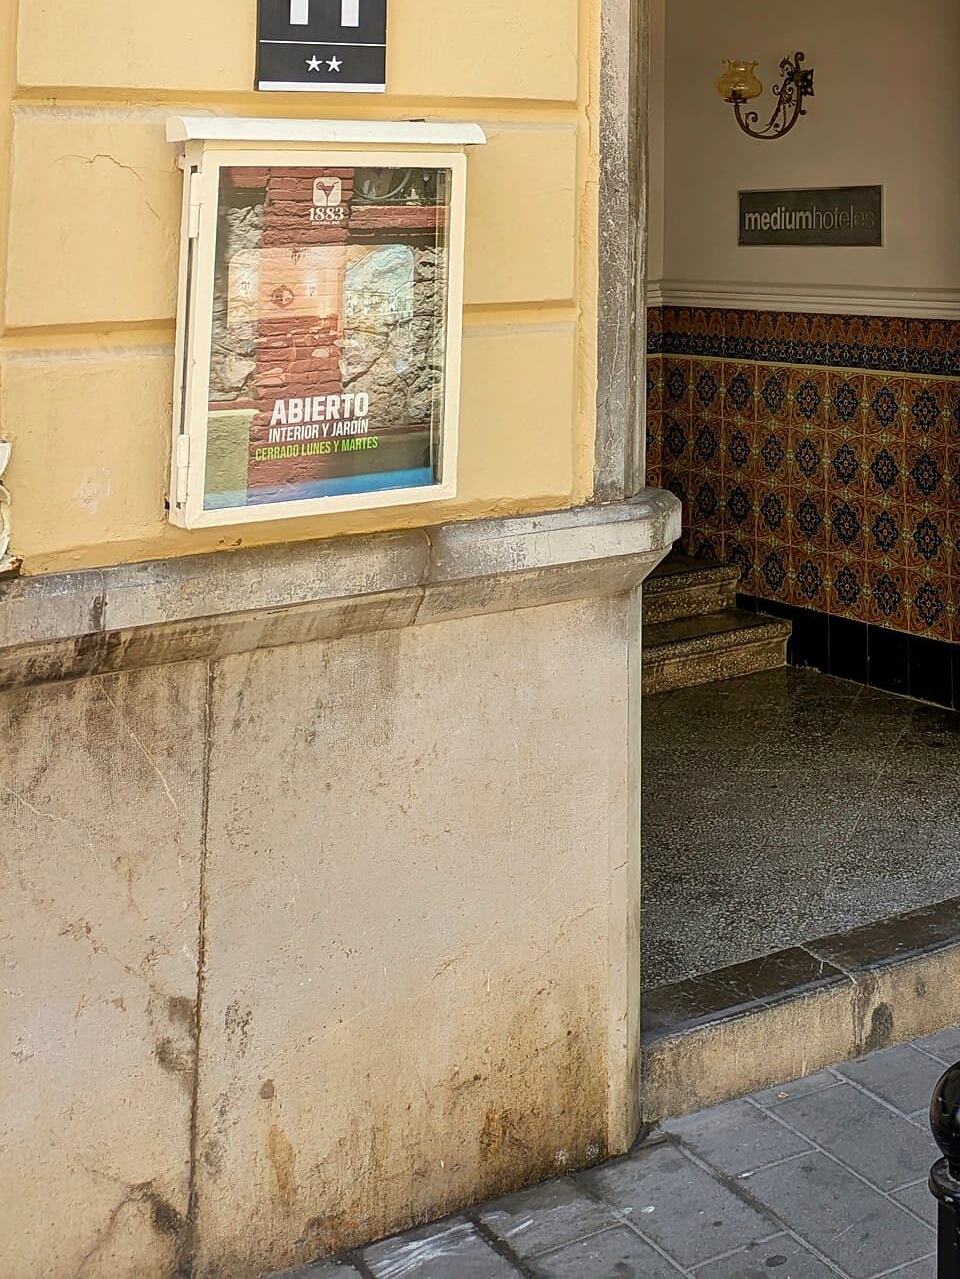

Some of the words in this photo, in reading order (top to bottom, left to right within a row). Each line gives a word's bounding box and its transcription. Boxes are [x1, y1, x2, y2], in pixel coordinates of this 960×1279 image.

[308, 207, 345, 221] 1883
[744, 205, 875, 231] mediumhoteles
[270, 392, 369, 426] ABIERTO
[268, 424, 320, 443] INTERIOR
[321, 423, 330, 438] Y
[331, 417, 369, 437] JARDÍN
[255, 444, 299, 462] CERRADO
[301, 441, 331, 457] LUNES
[333, 440, 341, 453] Y
[341, 436, 379, 453] MARTES
